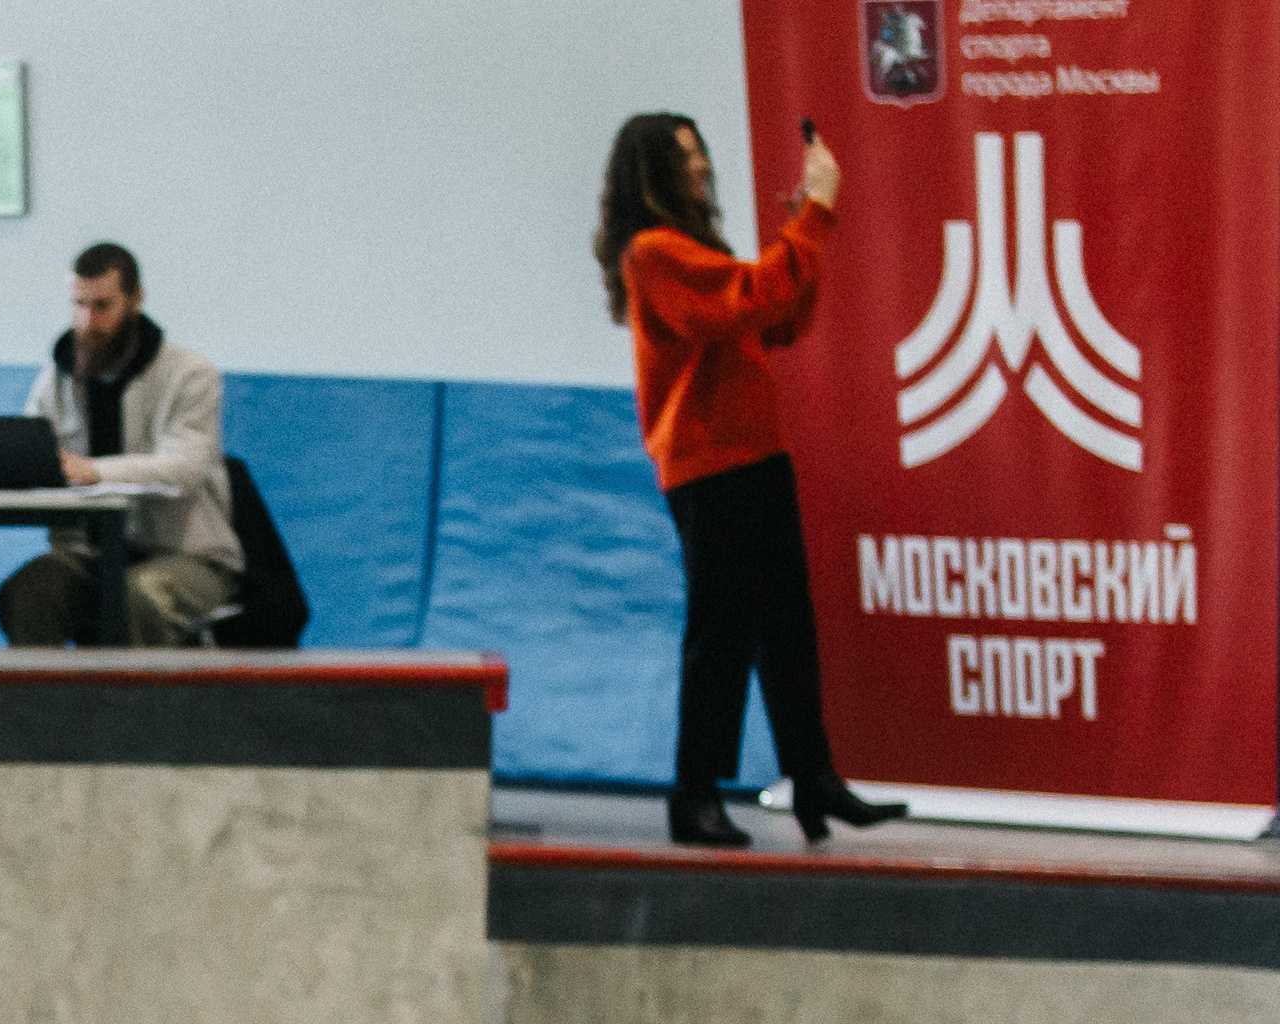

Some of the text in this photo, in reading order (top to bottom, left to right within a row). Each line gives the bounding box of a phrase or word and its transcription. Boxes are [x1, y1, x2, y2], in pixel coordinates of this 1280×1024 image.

[959, 34, 1051, 64] спорта
[960, 65, 1160, 102] города Москвы
[857, 523, 1197, 625] МОСКОВСКИЙ
[946, 634, 1106, 721] СПОРТ
